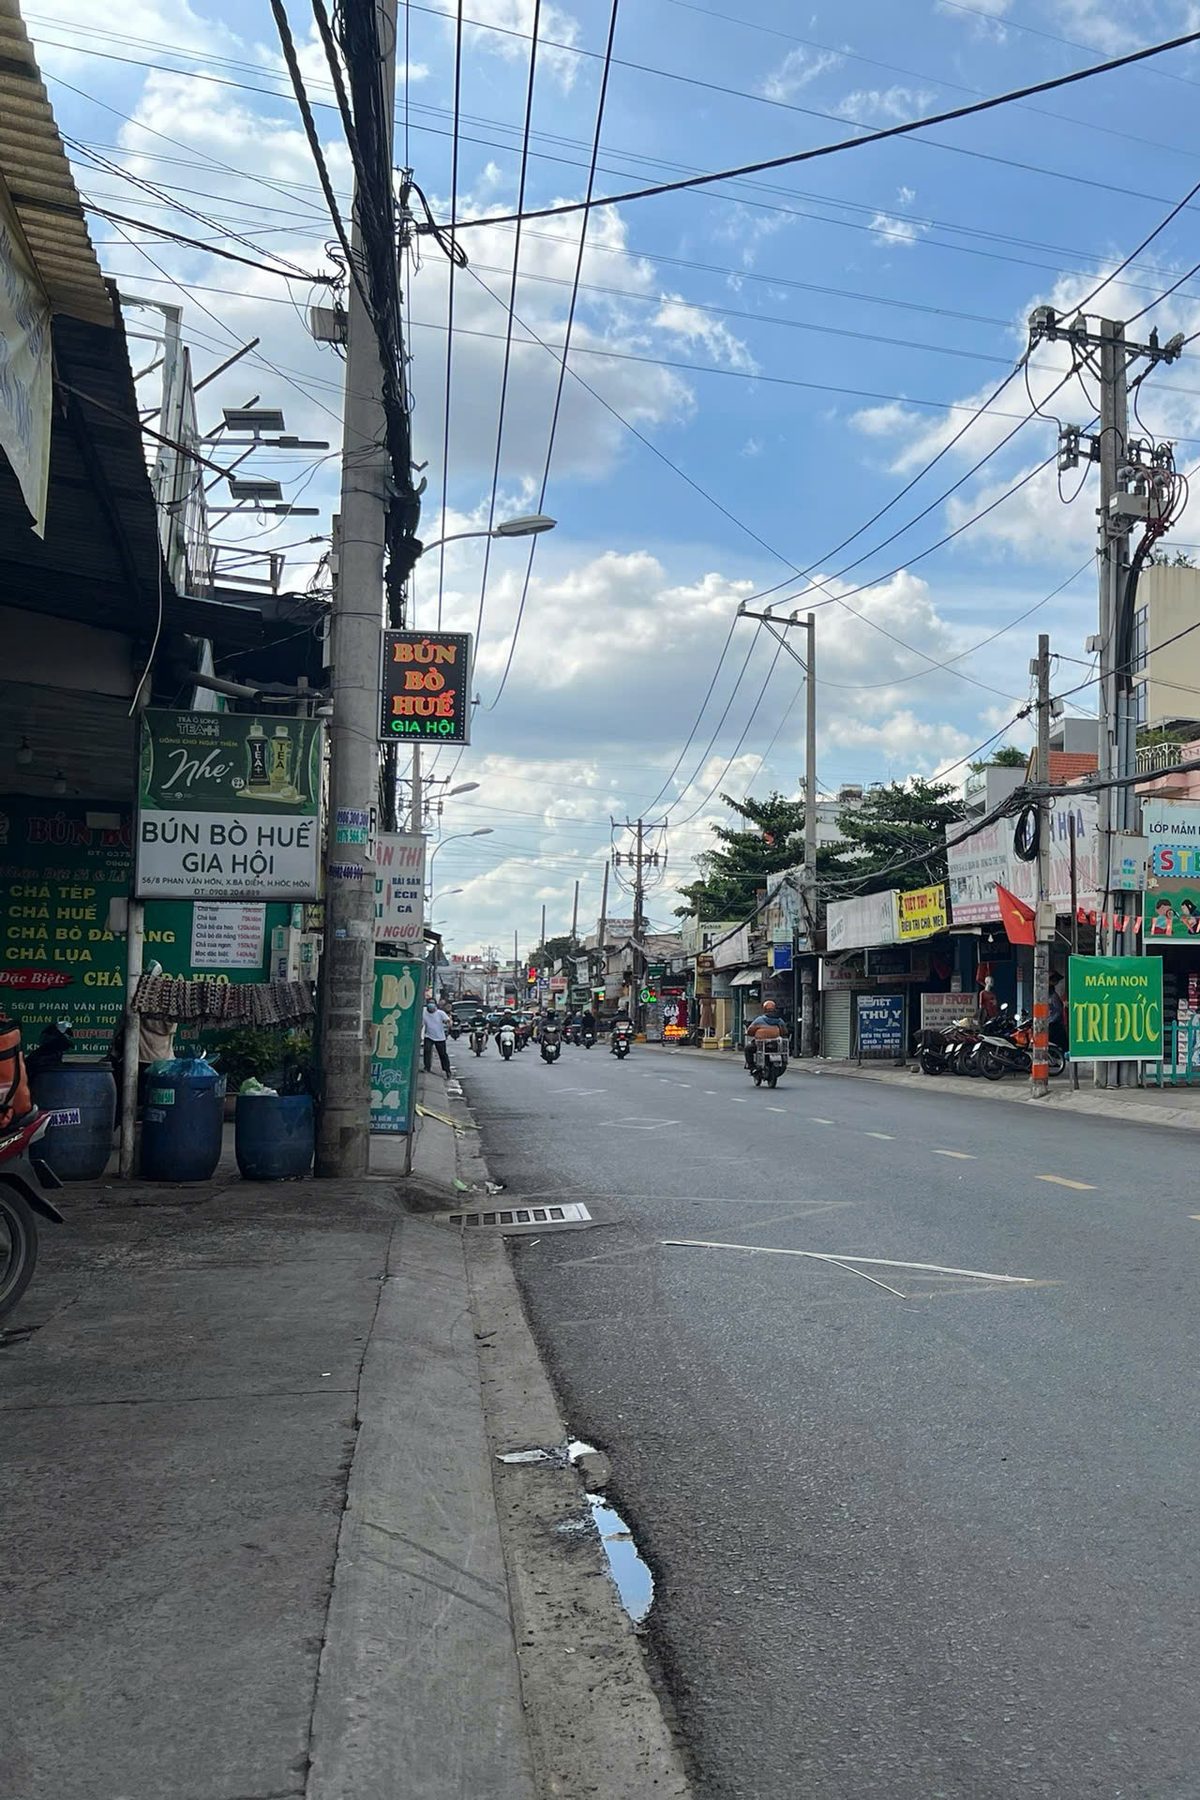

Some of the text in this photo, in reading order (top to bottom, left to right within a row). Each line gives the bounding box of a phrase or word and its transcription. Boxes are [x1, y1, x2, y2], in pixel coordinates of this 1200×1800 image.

[393, 639, 457, 664] BÚN
[404, 666, 445, 690] BÒ
[392, 690, 456, 716] HUẾ
[391, 719, 455, 735] GIA HỘI
[161, 749, 231, 789] Nhẹ
[142, 817, 199, 844] BÚN
[210, 819, 248, 846] BÒ
[257, 820, 314, 848] HUẾ
[1150, 821, 1169, 833] LỚP
[182, 850, 274, 878] GIA HỘI
[9, 881, 50, 898] CHẢ
[162, 877, 184, 885] PHAN
[8, 902, 98, 920] CHẢ HUẾ
[7, 924, 48, 940] CHẢ
[6, 944, 92, 965] CHẢ LỤA
[83, 967, 123, 987] CHẢ
[1121, 975, 1148, 987] NON
[39, 1003, 69, 1011] PHAN
[860, 1009, 902, 1020] THÚ Y
[1073, 994, 1160, 1042] TRÍ ĐỨC
